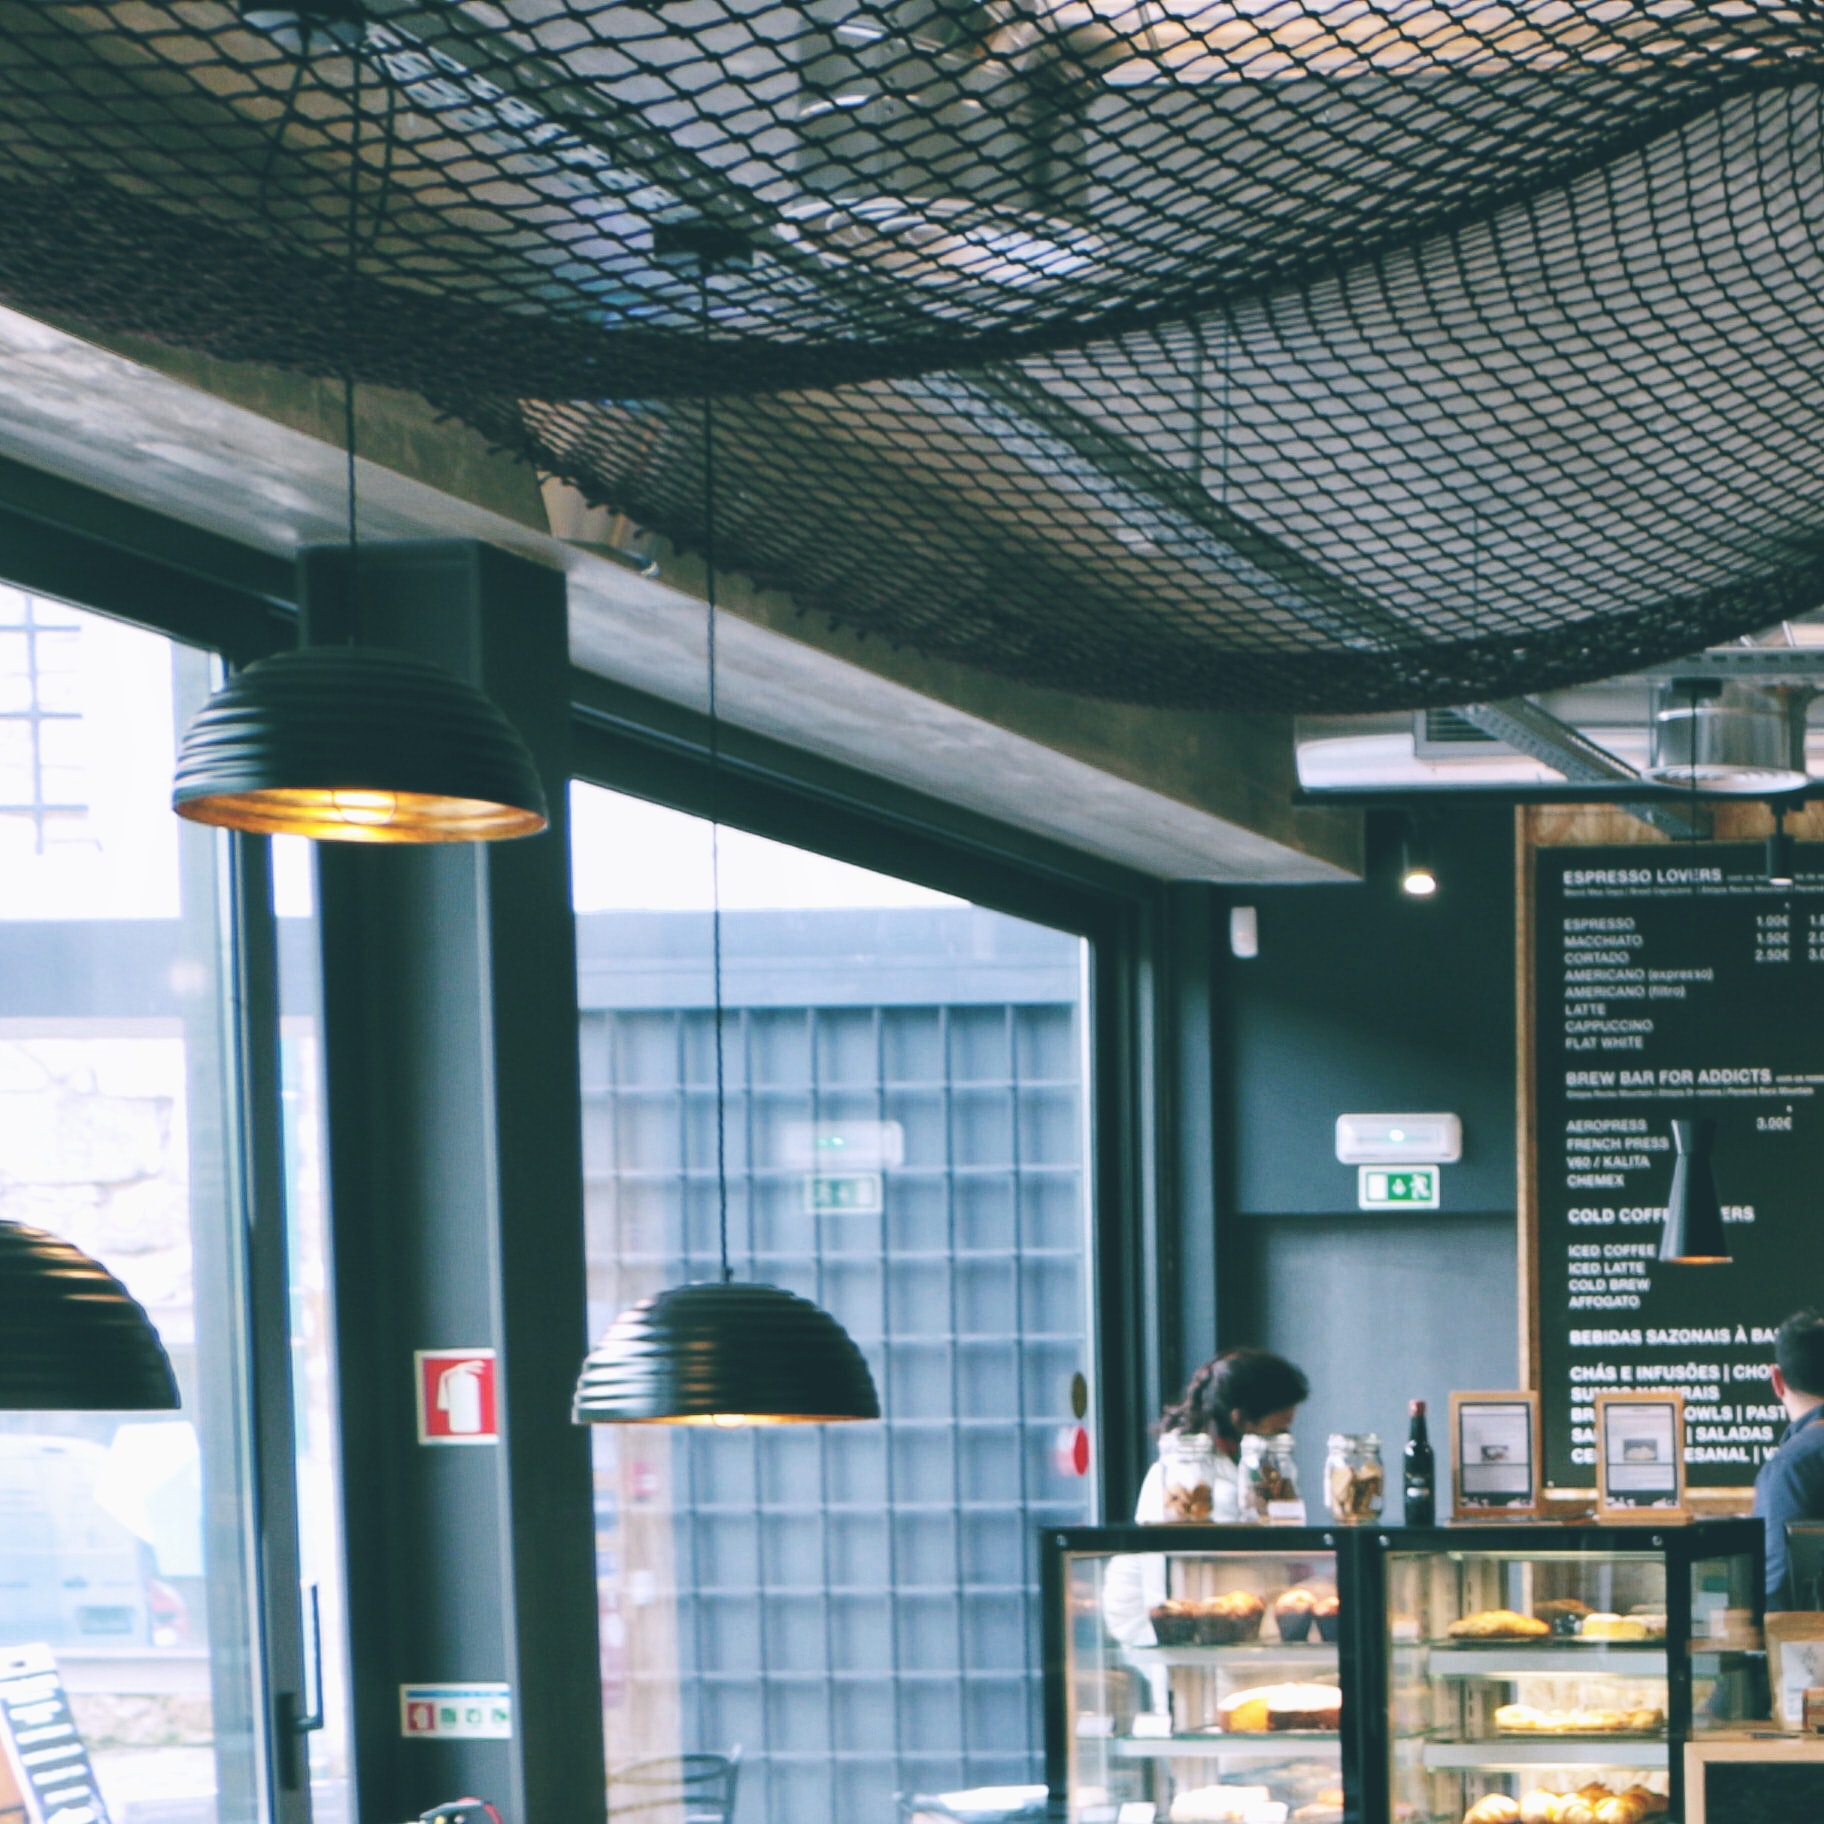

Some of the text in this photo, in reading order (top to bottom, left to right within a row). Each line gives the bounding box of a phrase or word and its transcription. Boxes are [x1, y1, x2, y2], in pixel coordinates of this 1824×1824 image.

[1563, 869, 1652, 885] ESPRESSO
[1564, 918, 1636, 932] ESPRESSO
[1756, 915, 1790, 928] 1.00€
[1564, 934, 1643, 949] MACCHIATO
[1564, 951, 1630, 965] CORTADO
[1565, 968, 1645, 982] AMERICANO
[1565, 985, 1645, 999] AMERICANO
[1648, 984, 1686, 1000] (filtro)
[1565, 1002, 1606, 1016] LATTE
[1565, 1019, 1653, 1034] CAPPUCCINO
[1565, 1036, 1597, 1051] FLAT
[1600, 1035, 1643, 1050] WHITE
[1566, 1071, 1616, 1087] BREW
[1619, 1070, 1655, 1086] BAR
[1659, 1070, 1694, 1085] FOR
[1697, 1067, 1771, 1085] ADDICTS
[1566, 1116, 1792, 1133] AEROPRESS 3.00€
[1566, 1137, 1622, 1152] FRENCH
[1624, 1136, 1669, 1151] PRESS
[1602, 1154, 1651, 1169] KALITA
[1566, 1174, 1625, 1188] CHEMEX
[1568, 1207, 1615, 1224] COLD
[1568, 1243, 1601, 1258] ICED
[1603, 1243, 1657, 1258] COFFEE
[1568, 1261, 1601, 1276] ICED
[1603, 1260, 1646, 1275] LATTE
[1568, 1278, 1607, 1293] COLD
[1609, 1277, 1651, 1292] BREW
[1568, 1294, 1641, 1310] AFFOGATO
[1569, 1329, 1642, 1346] BEBIDAS
[1645, 1327, 1731, 1344] SAZONAIS
[1734, 1324, 1748, 1344] À
[1569, 1360, 1618, 1381] CHÁS
[1620, 1364, 1633, 1381] E
[1635, 1359, 1721, 1380] INFUSÕES
[1695, 1425, 1774, 1443] SALADAS
